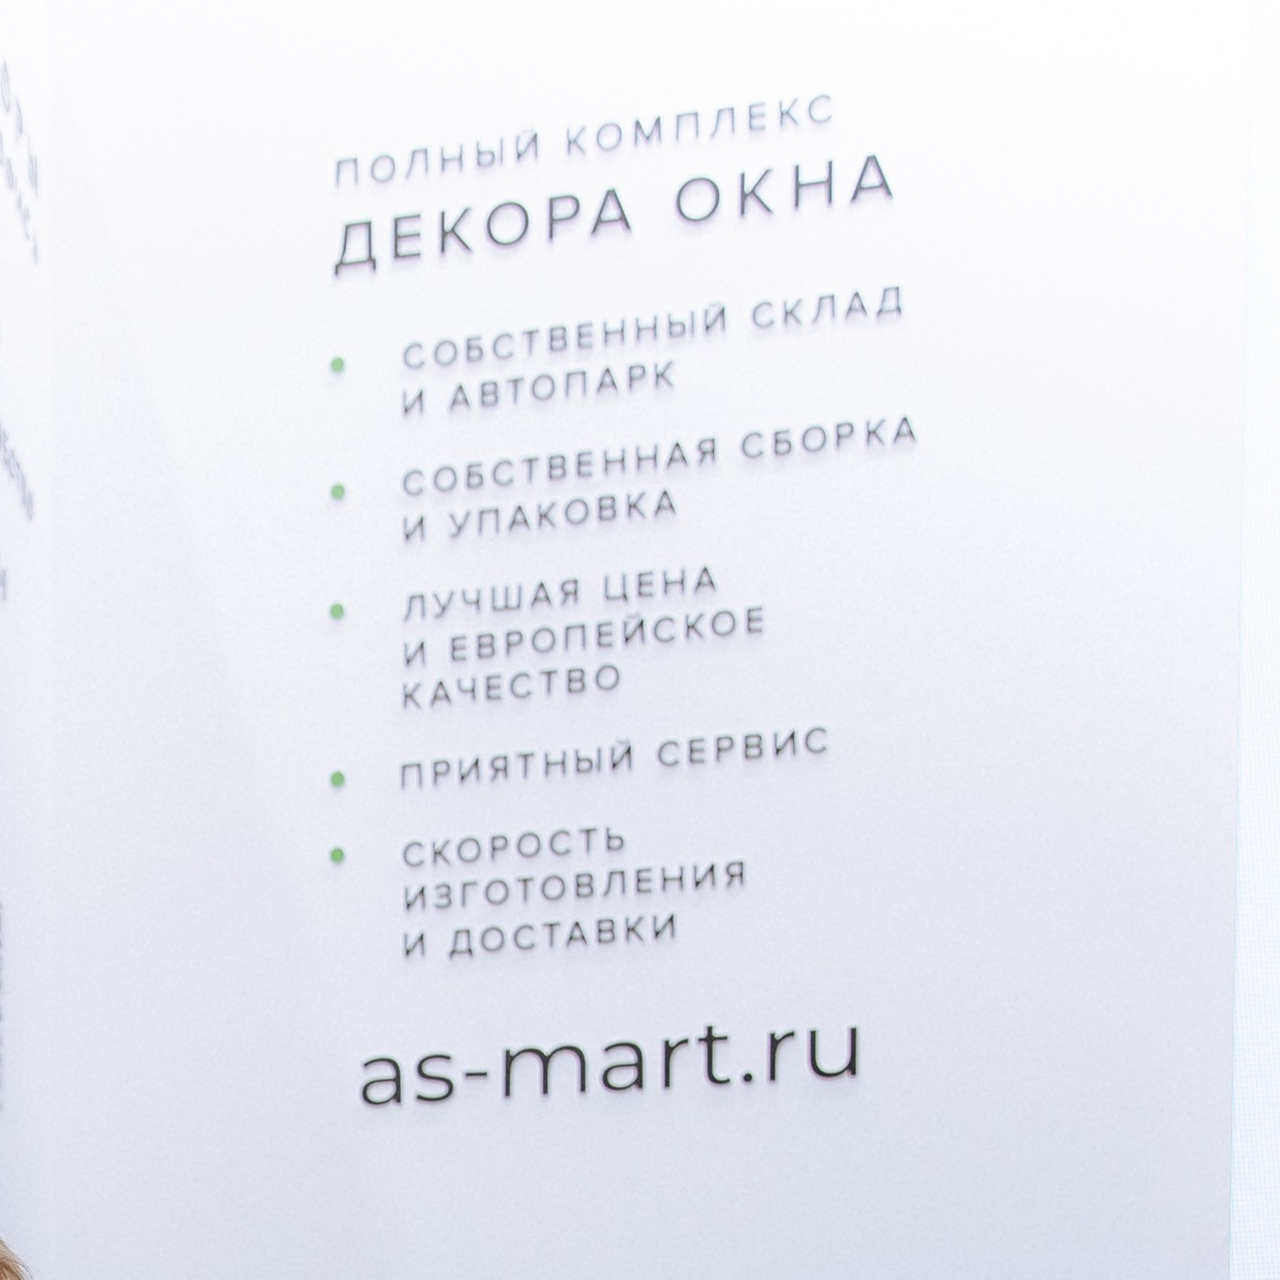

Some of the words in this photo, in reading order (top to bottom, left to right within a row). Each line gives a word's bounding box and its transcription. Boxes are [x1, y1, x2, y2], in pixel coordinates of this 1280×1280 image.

[334, 129, 540, 188] ПОЛНЫЙ
[564, 93, 833, 157] КОМПЛЕКС
[332, 187, 633, 279] ДЕКОРА
[673, 153, 894, 226] ОКНА
[401, 304, 728, 372] СОБСТВЕННЫЙ
[750, 284, 904, 331] СКЛАД
[401, 388, 426, 418] И
[447, 360, 674, 413] АВТОПАРК
[401, 436, 718, 498] СОБСТВЕННАЯ
[739, 414, 917, 462] СБОРКА
[402, 514, 426, 544] И
[448, 488, 677, 540] УПАКОВКА
[402, 577, 580, 624] ЛУЧШАЯ
[603, 565, 718, 605] ЦЕНА
[403, 639, 427, 669] И
[448, 605, 764, 664] ЕВРОПЕЙСКОЕ
[401, 662, 622, 710] КАЧЕСТВО
[399, 740, 634, 790] ПРИЯТНЫЙ
[655, 725, 828, 769] СЕРВИС
[400, 825, 627, 870] СКОРОСТЬ
[403, 859, 746, 913] ИЗГОТОВЛЕНИЯ
[402, 931, 427, 960] И
[447, 912, 677, 961] ДОСТАВКИ
[359, 1023, 859, 1108] as-mart.ru
